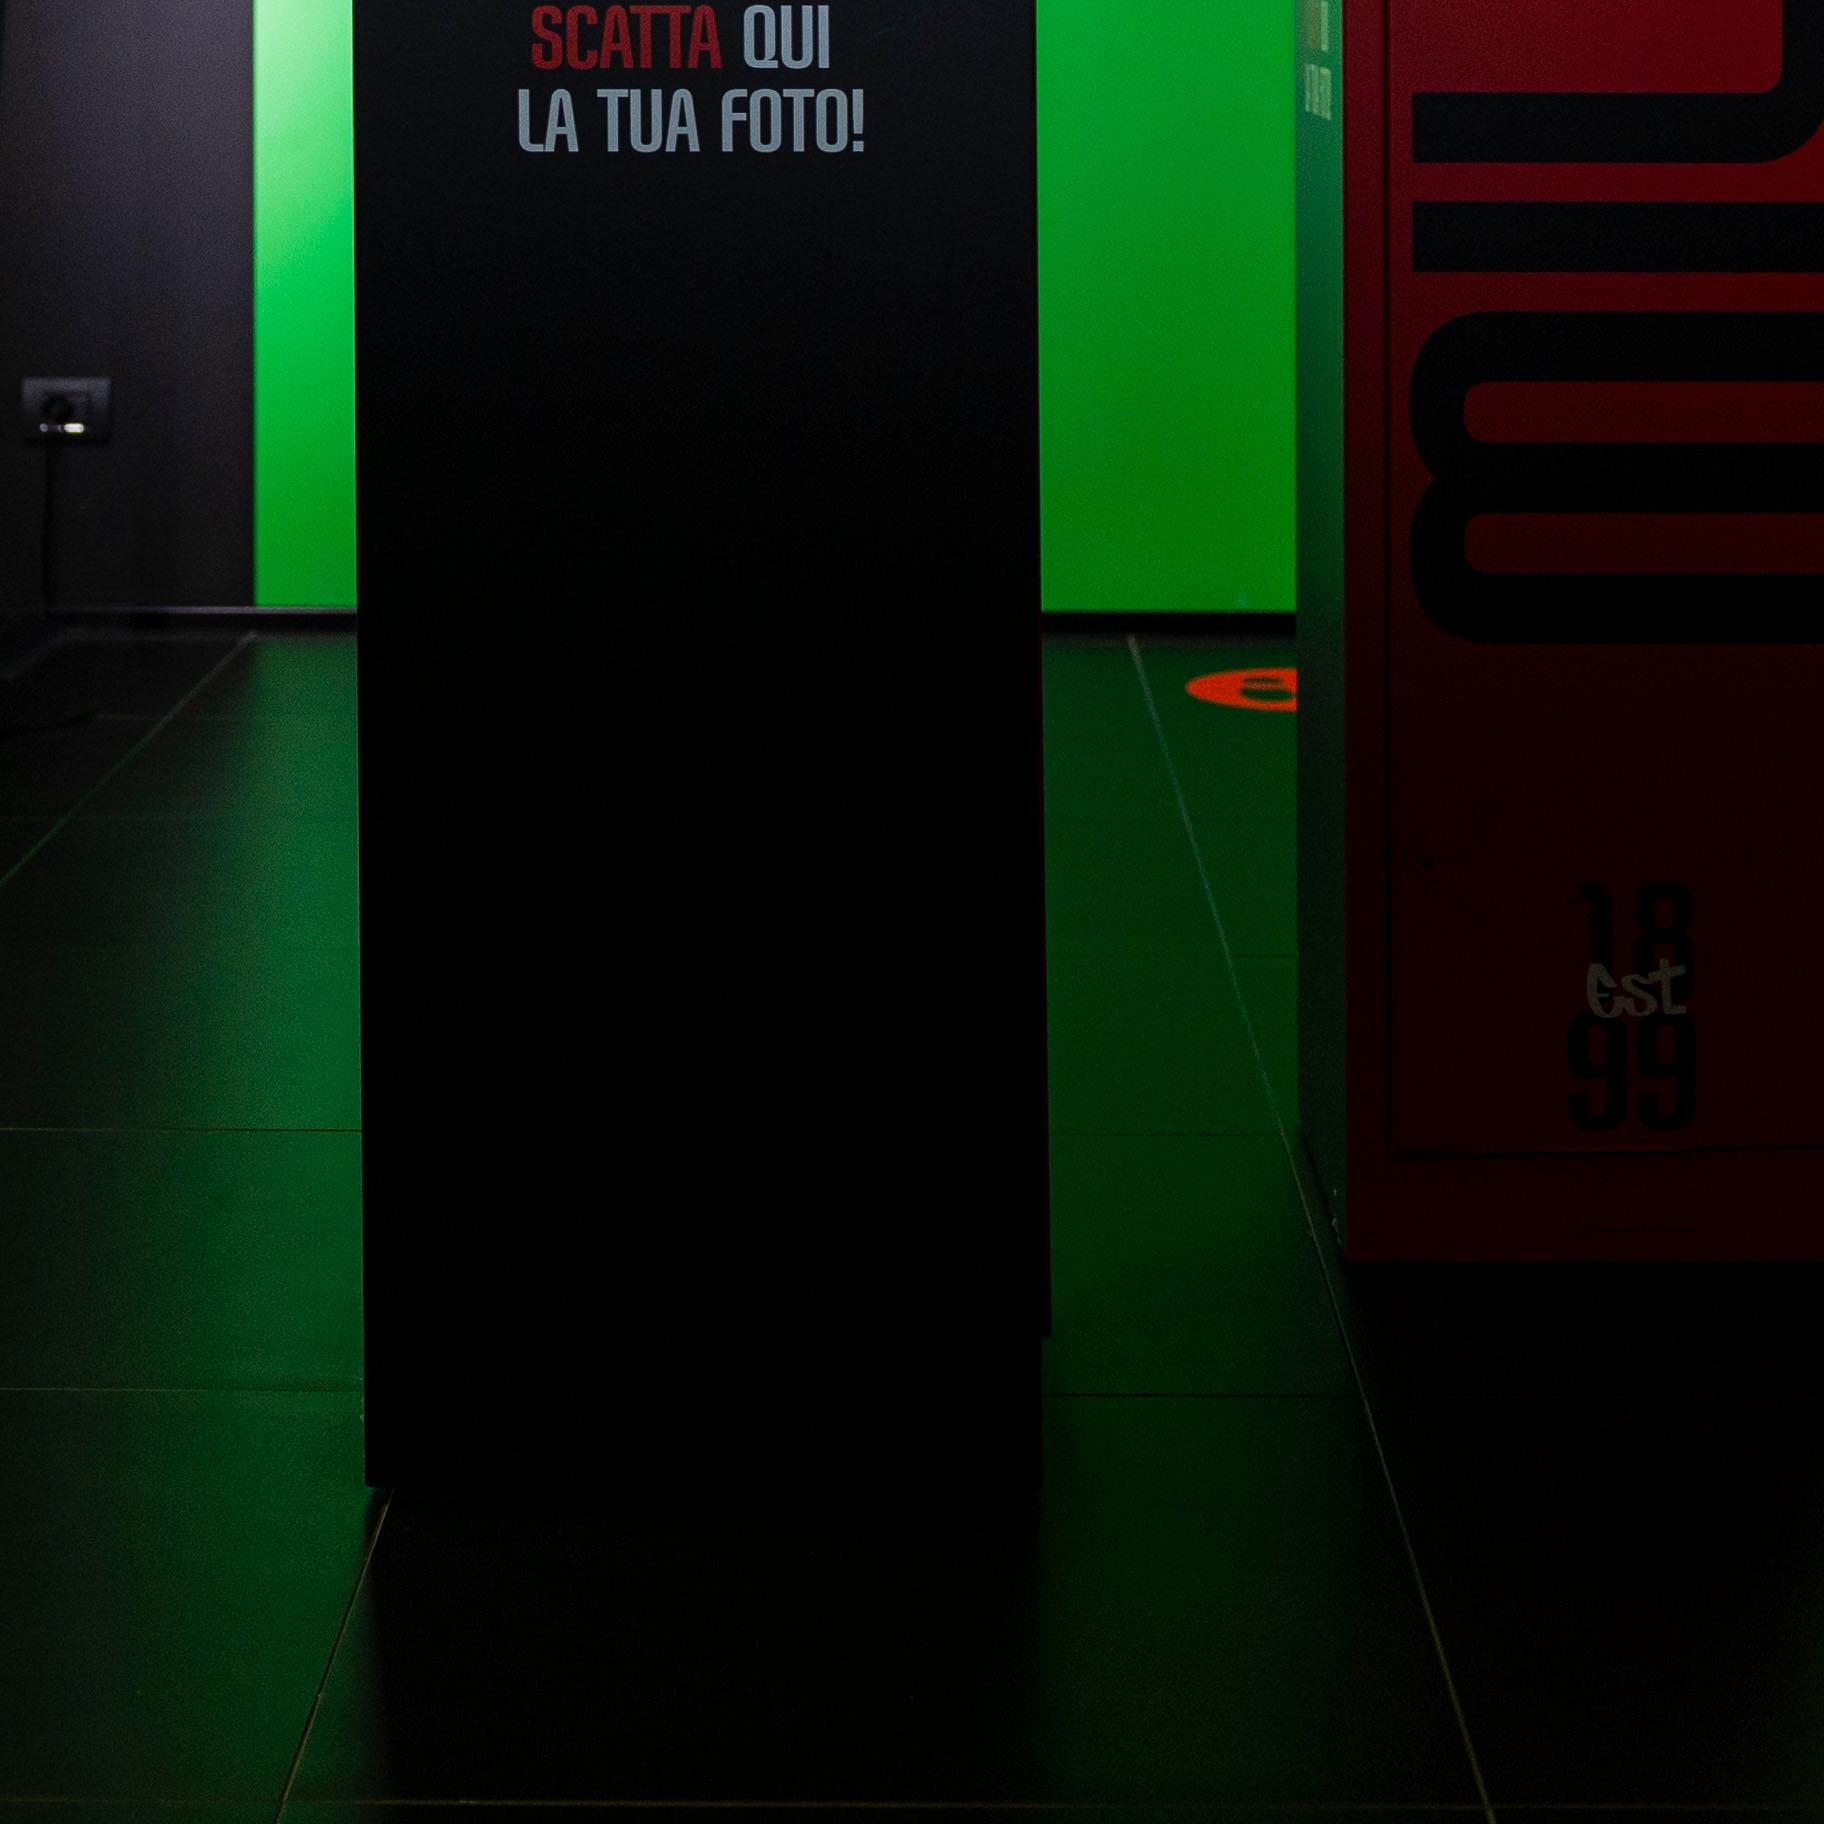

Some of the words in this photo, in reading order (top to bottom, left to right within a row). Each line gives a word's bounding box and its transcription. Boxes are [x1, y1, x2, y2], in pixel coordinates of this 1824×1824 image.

[530, 3, 723, 71] SCATTA
[742, 3, 831, 70] QUI
[517, 87, 580, 154] LA
[596, 87, 701, 154] TUA
[720, 87, 866, 154] FOTO!
[1567, 1013, 1696, 1129] 99
